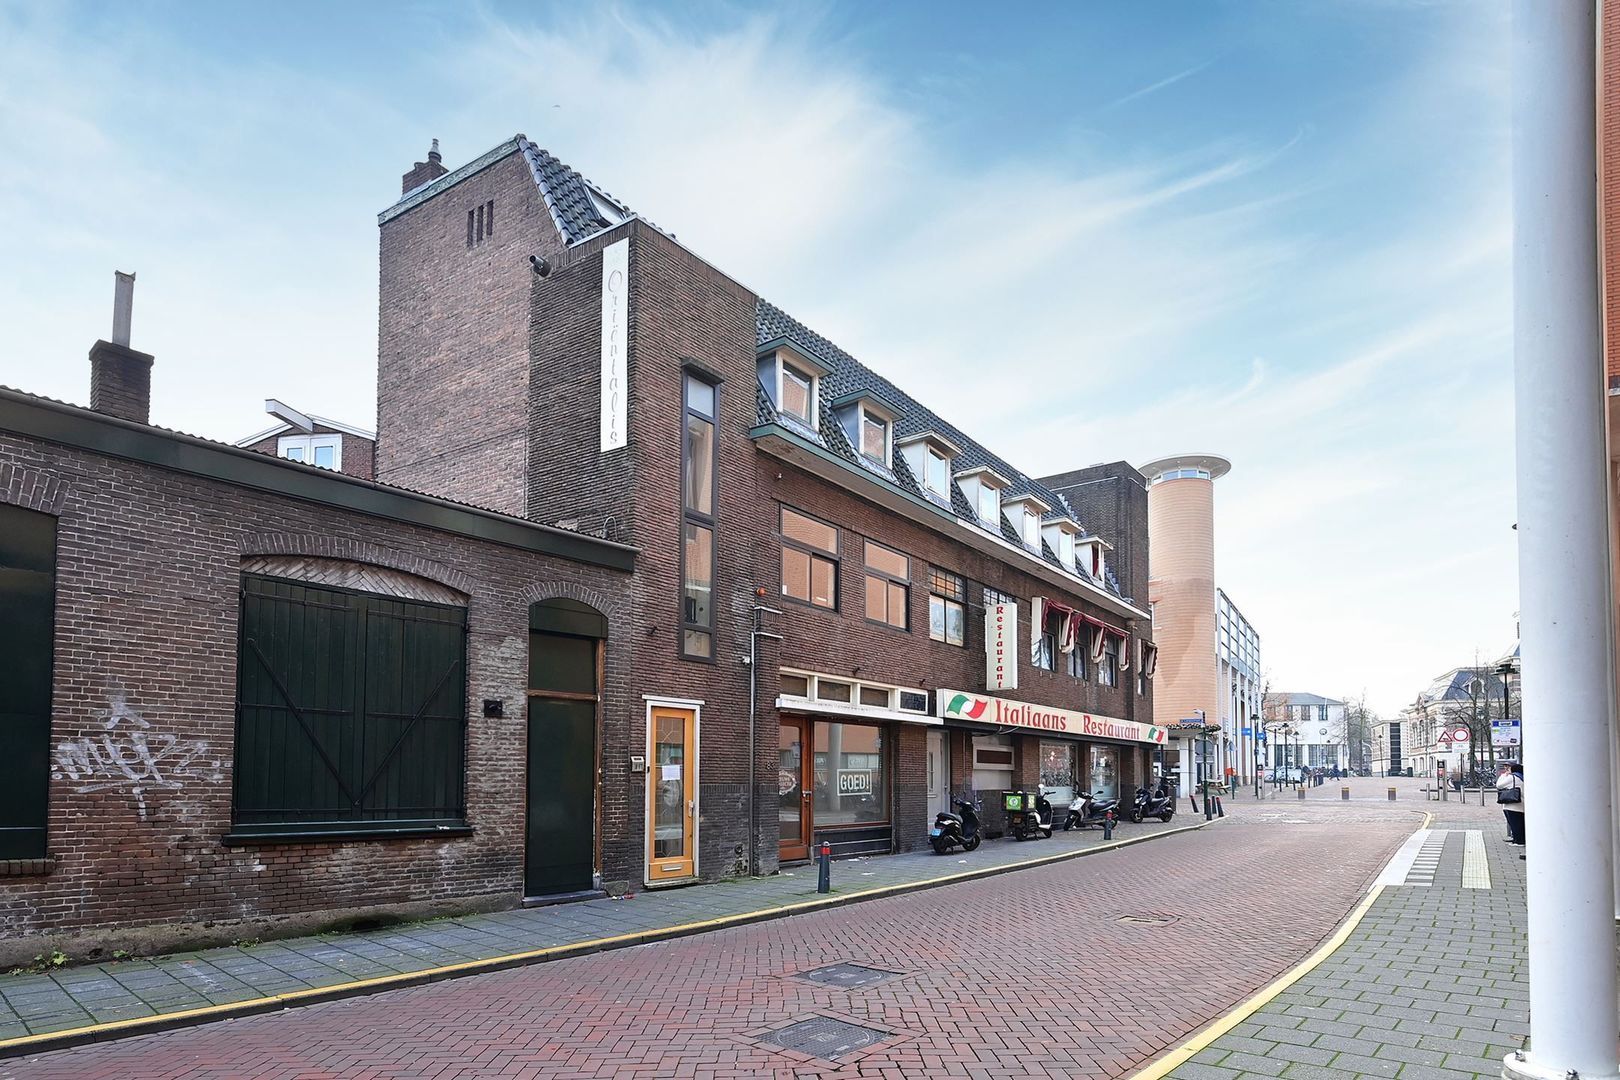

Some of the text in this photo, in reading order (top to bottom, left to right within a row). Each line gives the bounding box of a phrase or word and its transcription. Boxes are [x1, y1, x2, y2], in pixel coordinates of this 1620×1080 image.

[996, 606, 1004, 689] Restaurant
[995, 700, 1140, 740] Italiaans Restaurant
[840, 774, 869, 791] GOED!
